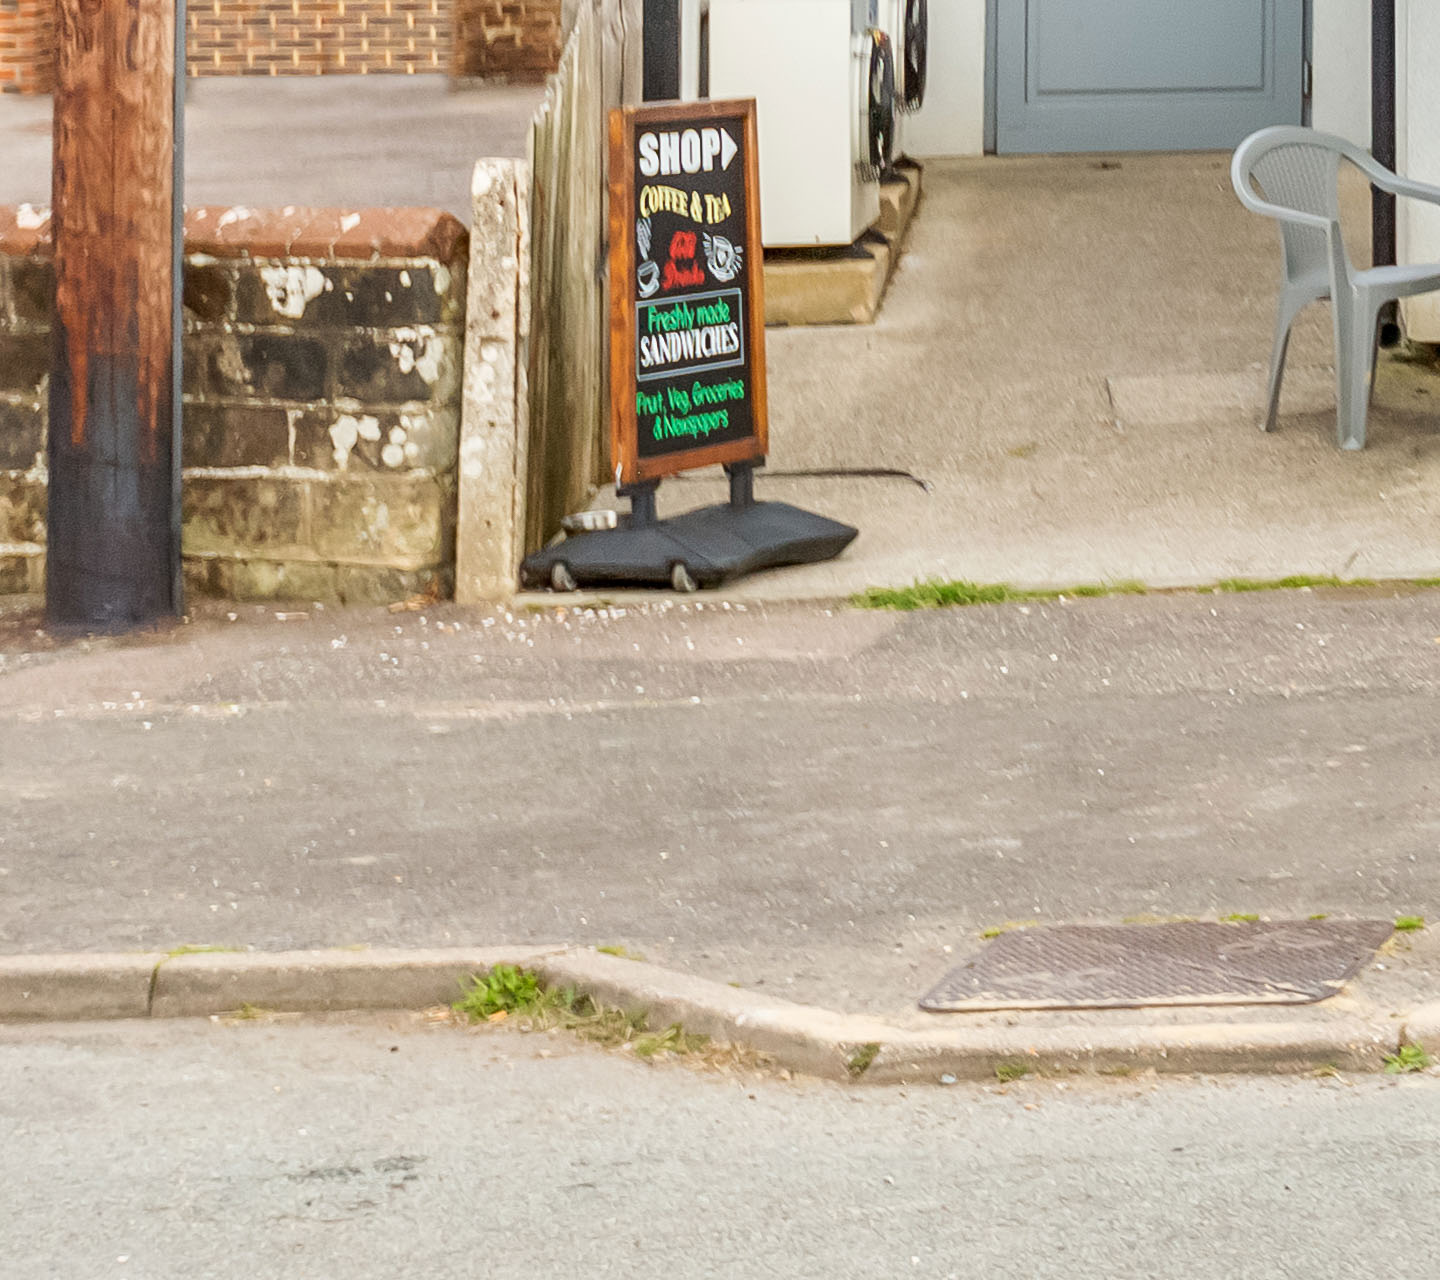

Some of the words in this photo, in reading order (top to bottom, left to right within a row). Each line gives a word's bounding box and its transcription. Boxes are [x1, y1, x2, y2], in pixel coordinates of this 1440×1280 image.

[639, 127, 721, 177] SHOP
[640, 185, 689, 218] COFFEE
[690, 190, 703, 224] &
[704, 192, 732, 225] TEA
[647, 301, 694, 333] Freshly
[697, 296, 731, 325] made
[640, 321, 739, 368] SANDWICHES
